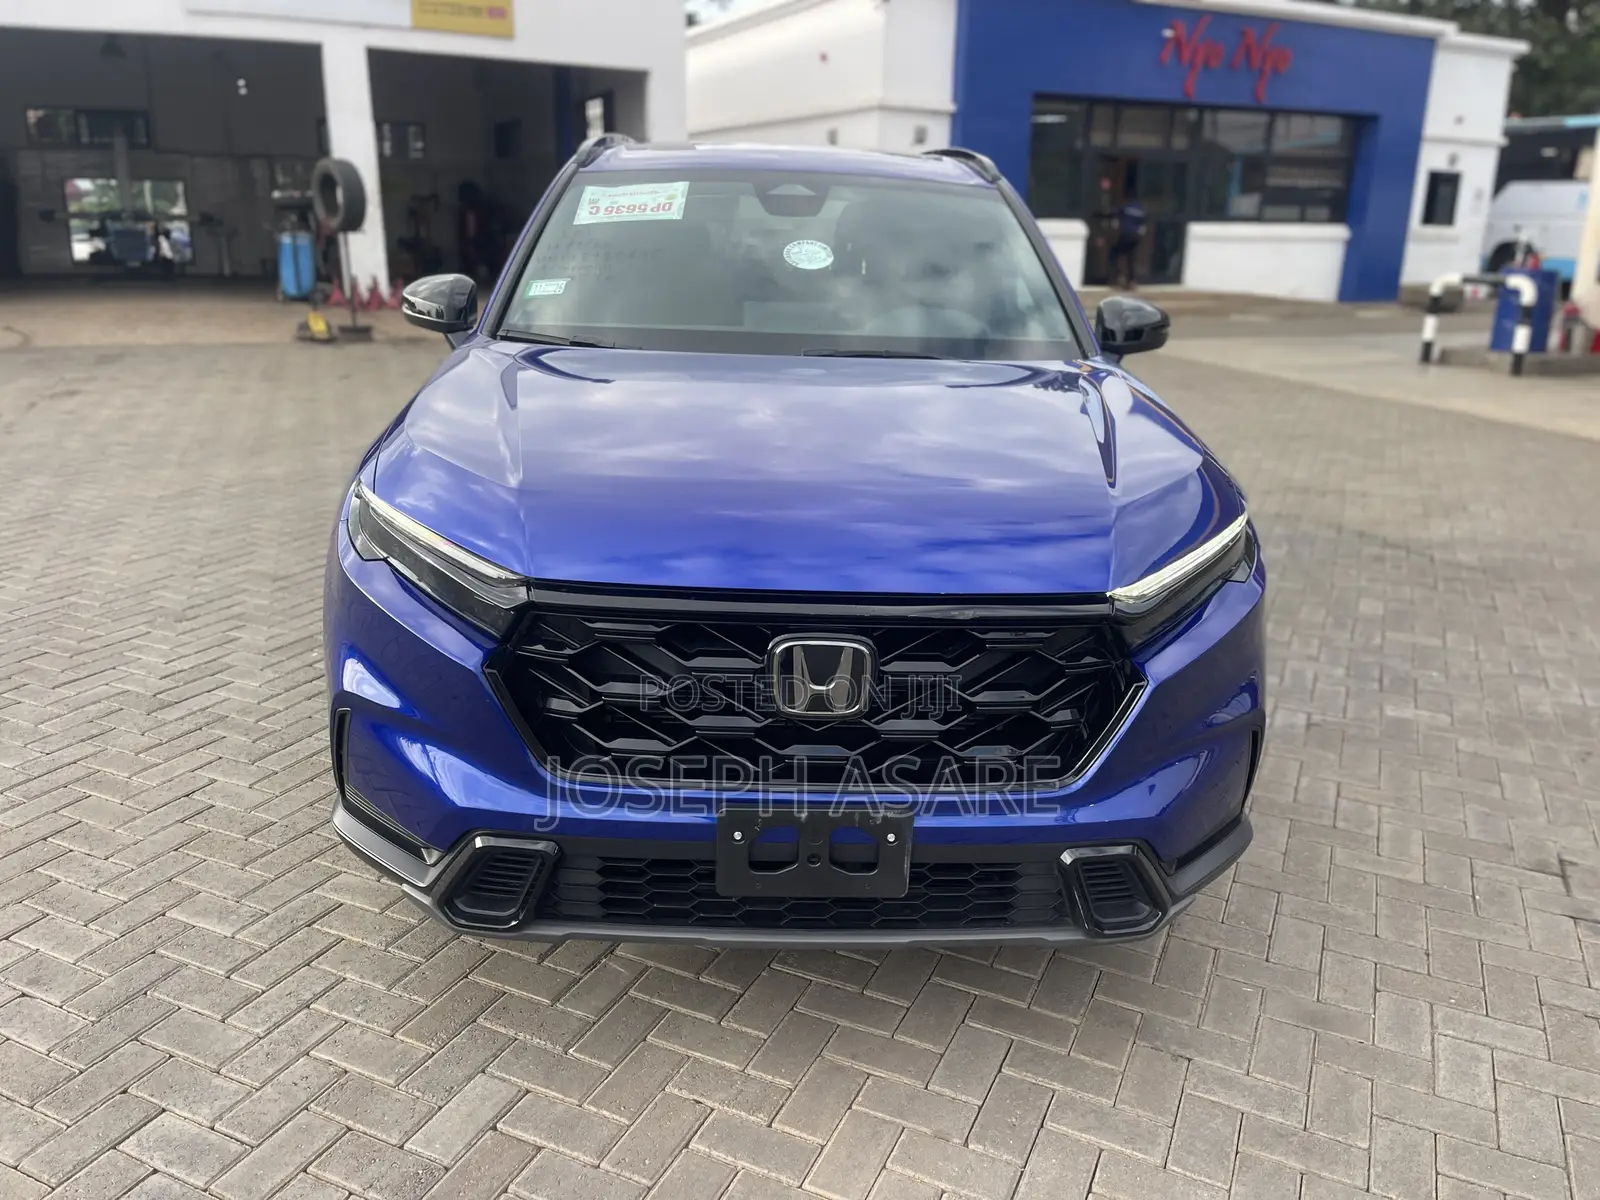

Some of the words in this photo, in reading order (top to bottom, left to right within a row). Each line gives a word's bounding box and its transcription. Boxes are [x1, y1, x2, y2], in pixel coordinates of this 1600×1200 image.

[588, 206, 600, 216] C
[603, 204, 649, 216] 5635
[650, 202, 673, 213] DP
